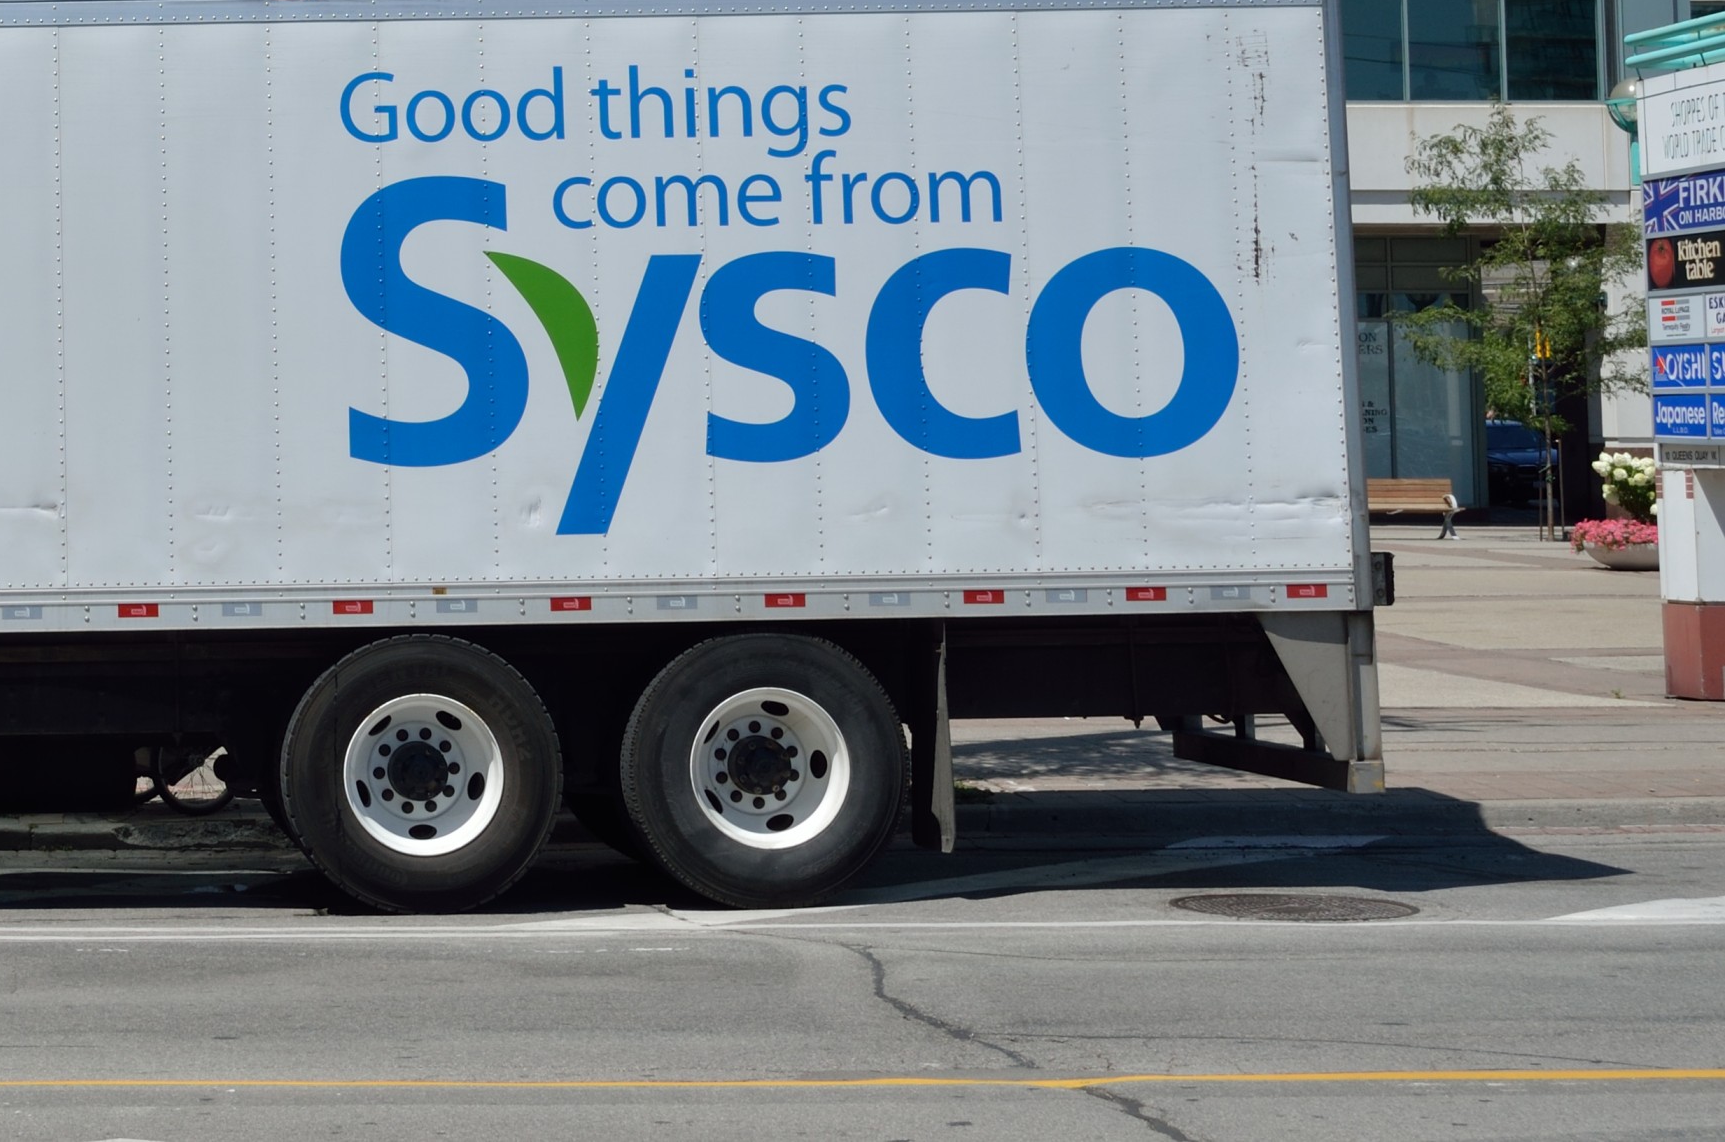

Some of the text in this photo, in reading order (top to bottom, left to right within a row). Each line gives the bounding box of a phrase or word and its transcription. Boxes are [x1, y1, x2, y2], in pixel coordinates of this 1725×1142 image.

[339, 63, 853, 159] Good things
[1670, 96, 1706, 127] SHOPPES
[1708, 93, 1719, 120] OF
[1662, 131, 1689, 160] WORLD
[1692, 127, 1717, 156] TRADE
[551, 148, 1004, 230] come from
[1679, 210, 1693, 224] ON
[1677, 238, 1721, 262] kitchen
[1685, 257, 1715, 280] table
[339, 174, 1240, 537] Sysco
[1666, 351, 1706, 381] OYSHI
[1655, 401, 1706, 428] Japanese
[1672, 450, 1694, 460] QUEENS
[1695, 450, 1709, 460] QUAY
